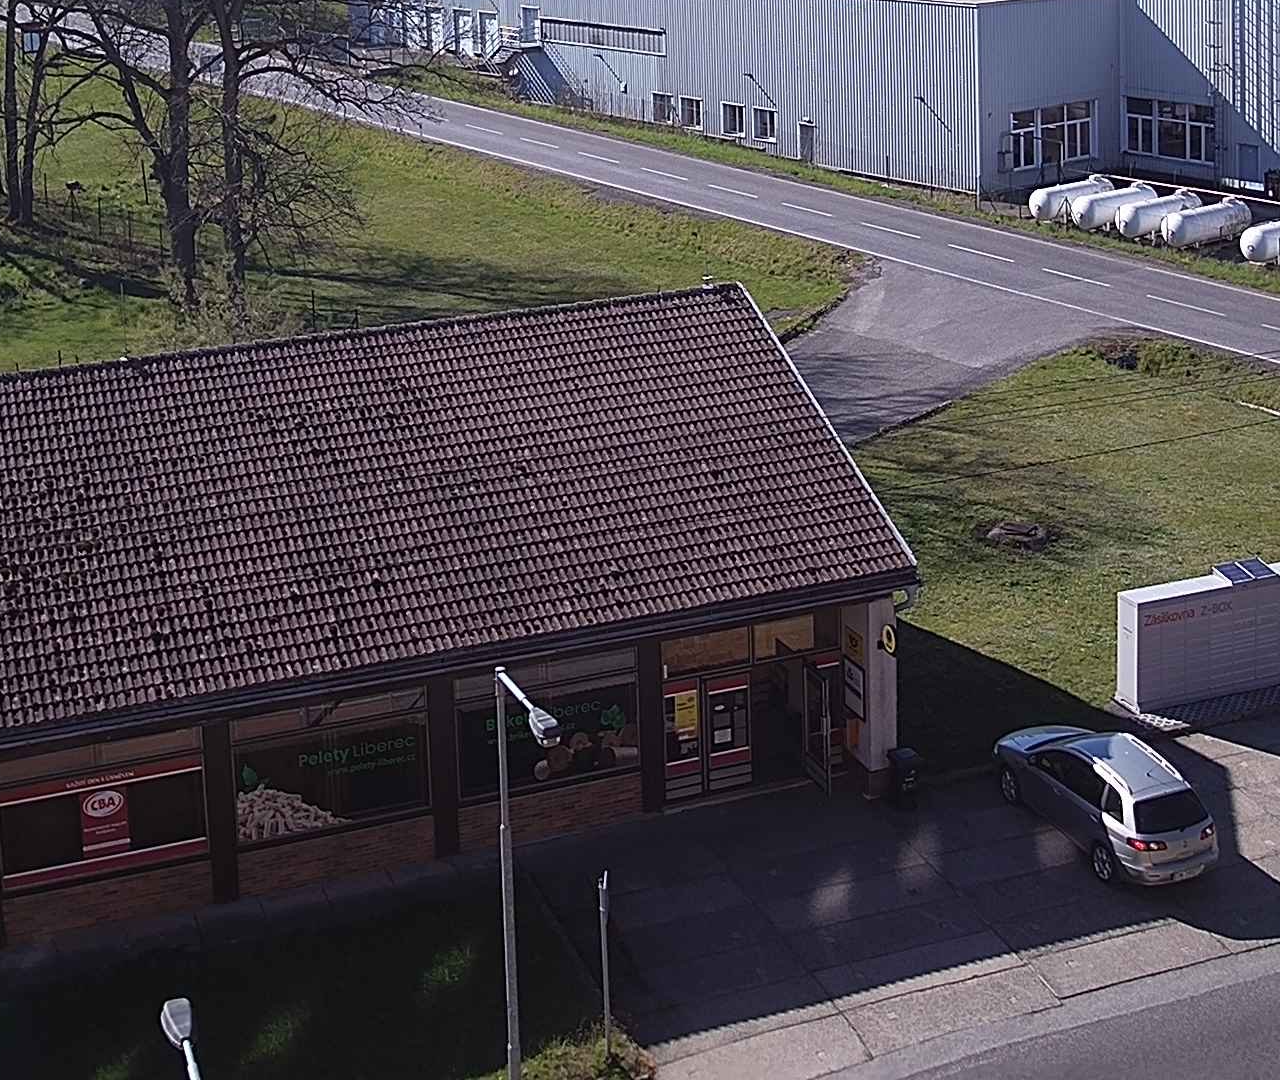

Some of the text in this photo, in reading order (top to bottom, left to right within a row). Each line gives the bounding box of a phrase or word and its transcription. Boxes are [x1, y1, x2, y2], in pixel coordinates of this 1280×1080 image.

[298, 736, 416, 767] Pelety Liberec
[90, 796, 116, 811] CBA
